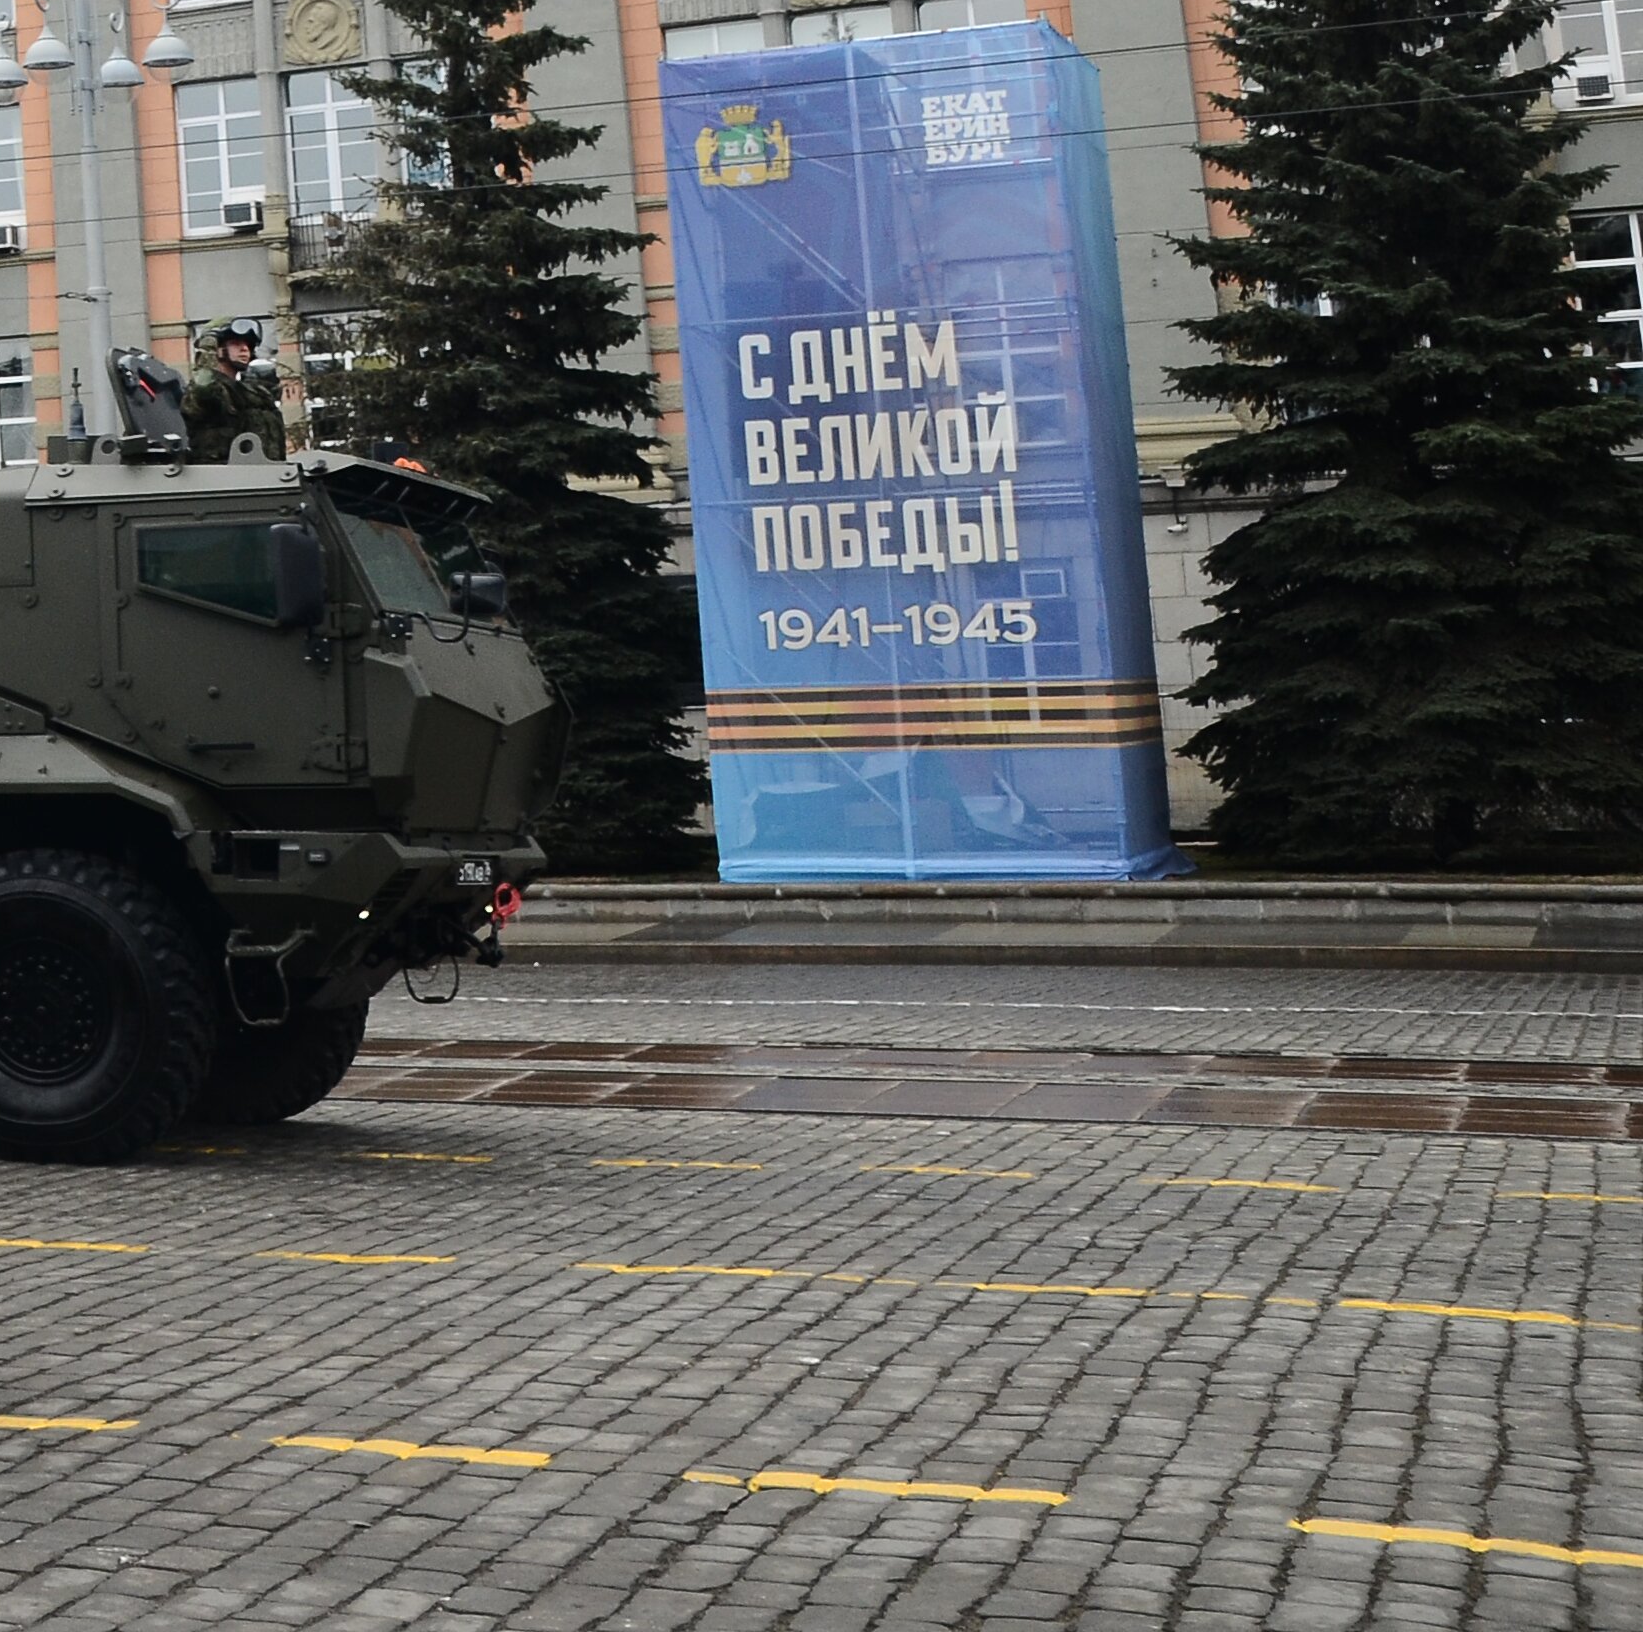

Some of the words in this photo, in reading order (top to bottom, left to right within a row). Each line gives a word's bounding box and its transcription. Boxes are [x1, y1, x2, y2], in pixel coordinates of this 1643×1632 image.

[921, 90, 1007, 119] ЕКАТ
[923, 112, 1011, 142] ЕРИН
[925, 135, 1012, 165] БУРГ
[738, 334, 774, 399] С
[788, 309, 959, 404] ДНЁМ
[744, 391, 1017, 485] ВЕЛИКОЙ
[752, 480, 1019, 574] ПОБЕДЫ!
